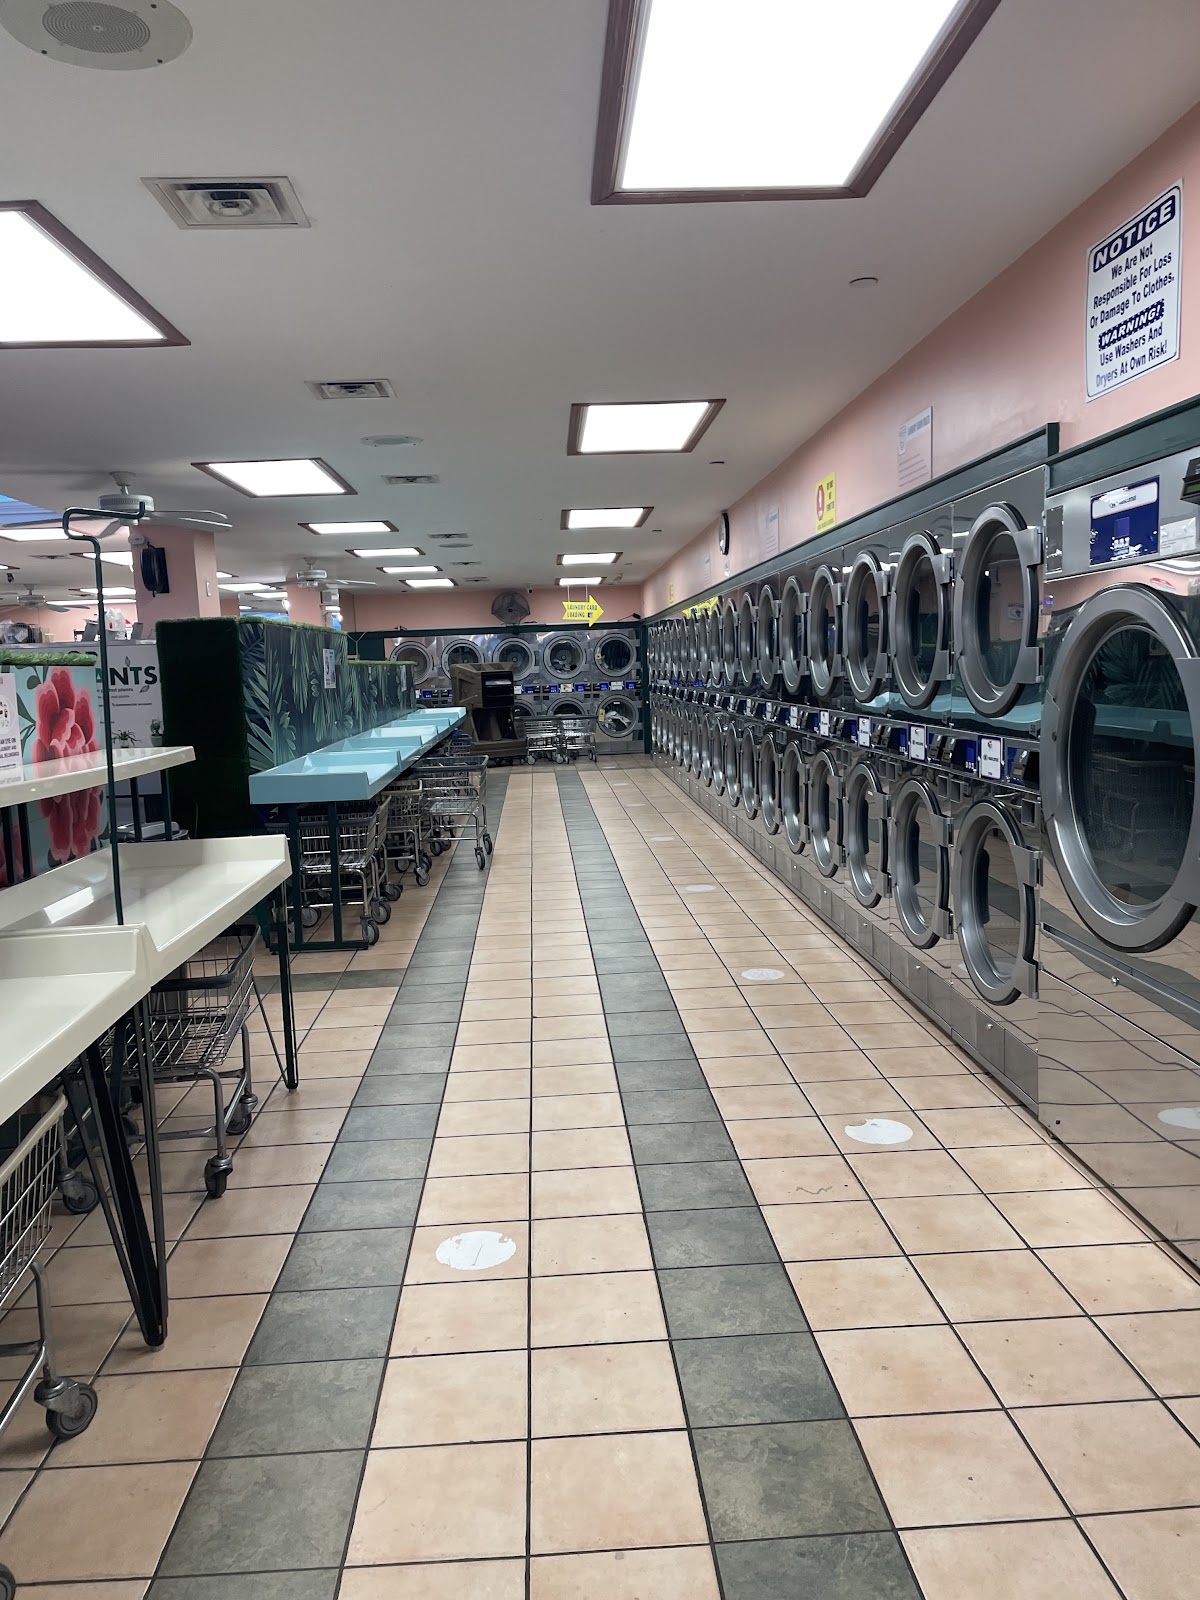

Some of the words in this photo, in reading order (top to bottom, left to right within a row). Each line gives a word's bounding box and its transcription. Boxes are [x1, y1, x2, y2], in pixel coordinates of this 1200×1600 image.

[1094, 199, 1173, 270] NOTICE
[1093, 274, 1138, 309] Responsible
[1139, 265, 1152, 281] For
[1153, 252, 1172, 272] Loss
[1111, 264, 1123, 280] We
[1124, 255, 1138, 272] Are
[1139, 241, 1153, 262] Not
[1089, 315, 1099, 329] Or
[1100, 299, 1130, 324] Damage
[1131, 291, 1141, 305] To
[1101, 304, 1161, 347] WARNING!
[1096, 367, 1118, 388] Dryers
[1119, 360, 1128, 376] At
[1129, 353, 1147, 371] Own
[1148, 339, 1168, 362] Risk!
[1099, 350, 1114, 367] Use
[1114, 334, 1146, 359] Washers
[1147, 321, 1163, 342] And
